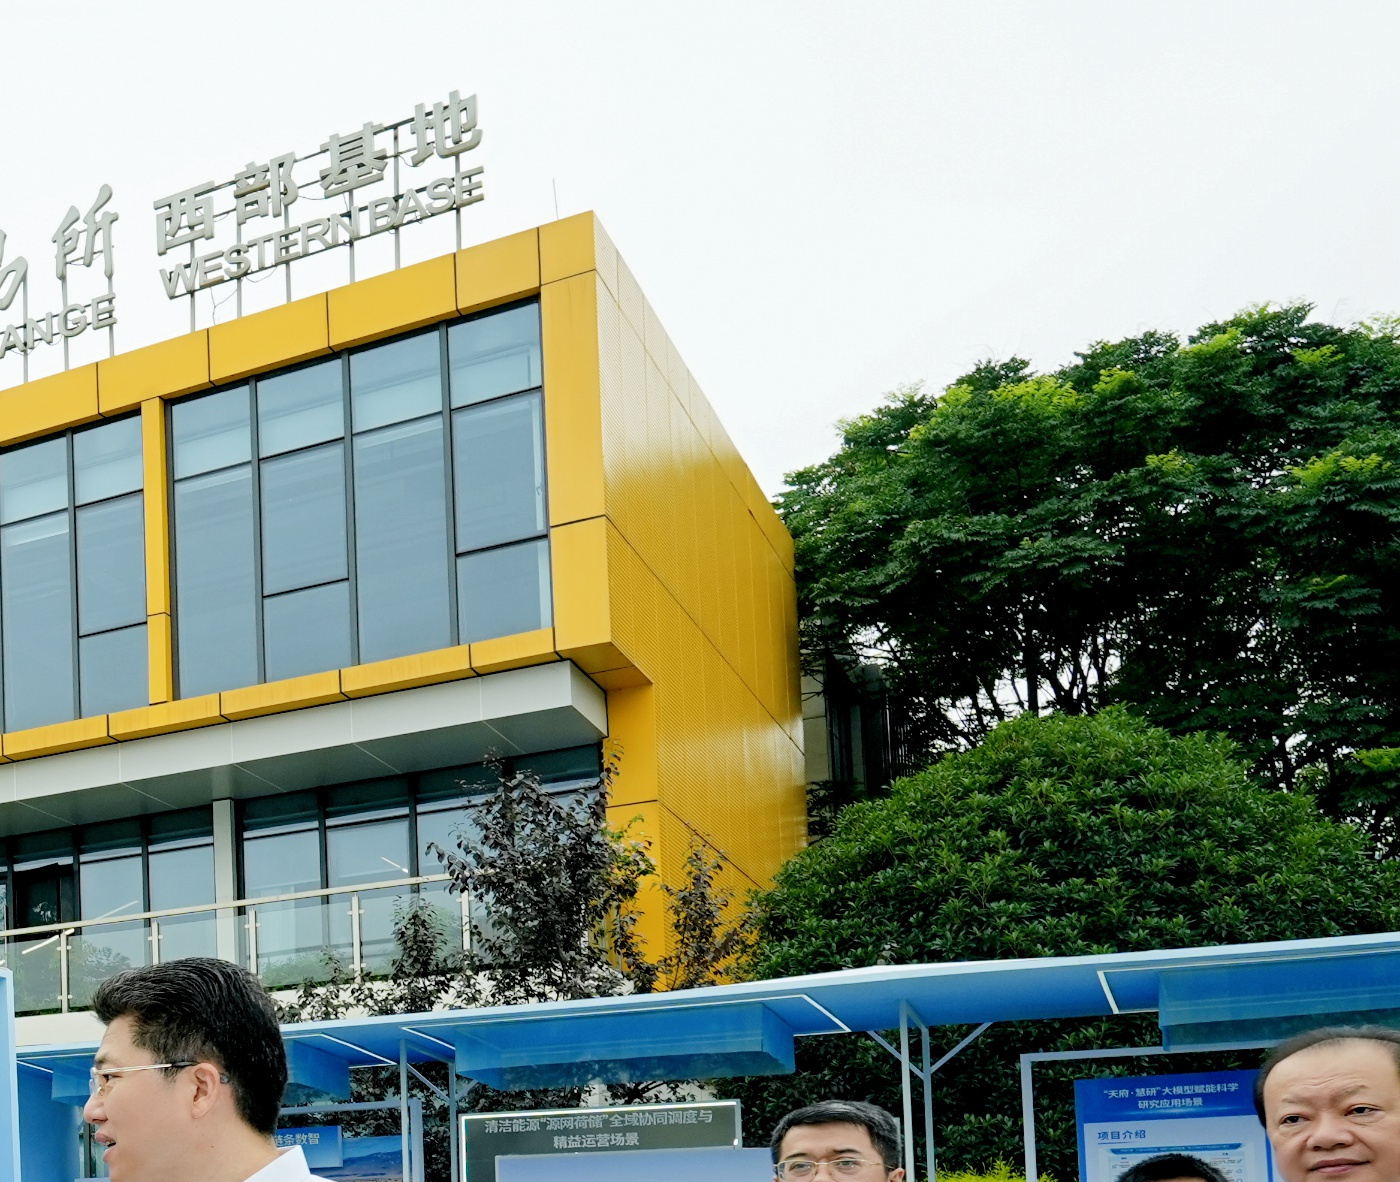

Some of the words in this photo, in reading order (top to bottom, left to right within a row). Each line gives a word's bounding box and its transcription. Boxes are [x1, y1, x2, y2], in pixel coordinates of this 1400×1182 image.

[154, 89, 483, 256] 西部基地
[158, 206, 362, 300] WESTERN
[368, 165, 485, 232] BASE
[1138, 1097, 1204, 1109] 研究应用场景
[553, 1132, 639, 1149] 精益运营场景
[1097, 1130, 1146, 1140] 项目介绍
